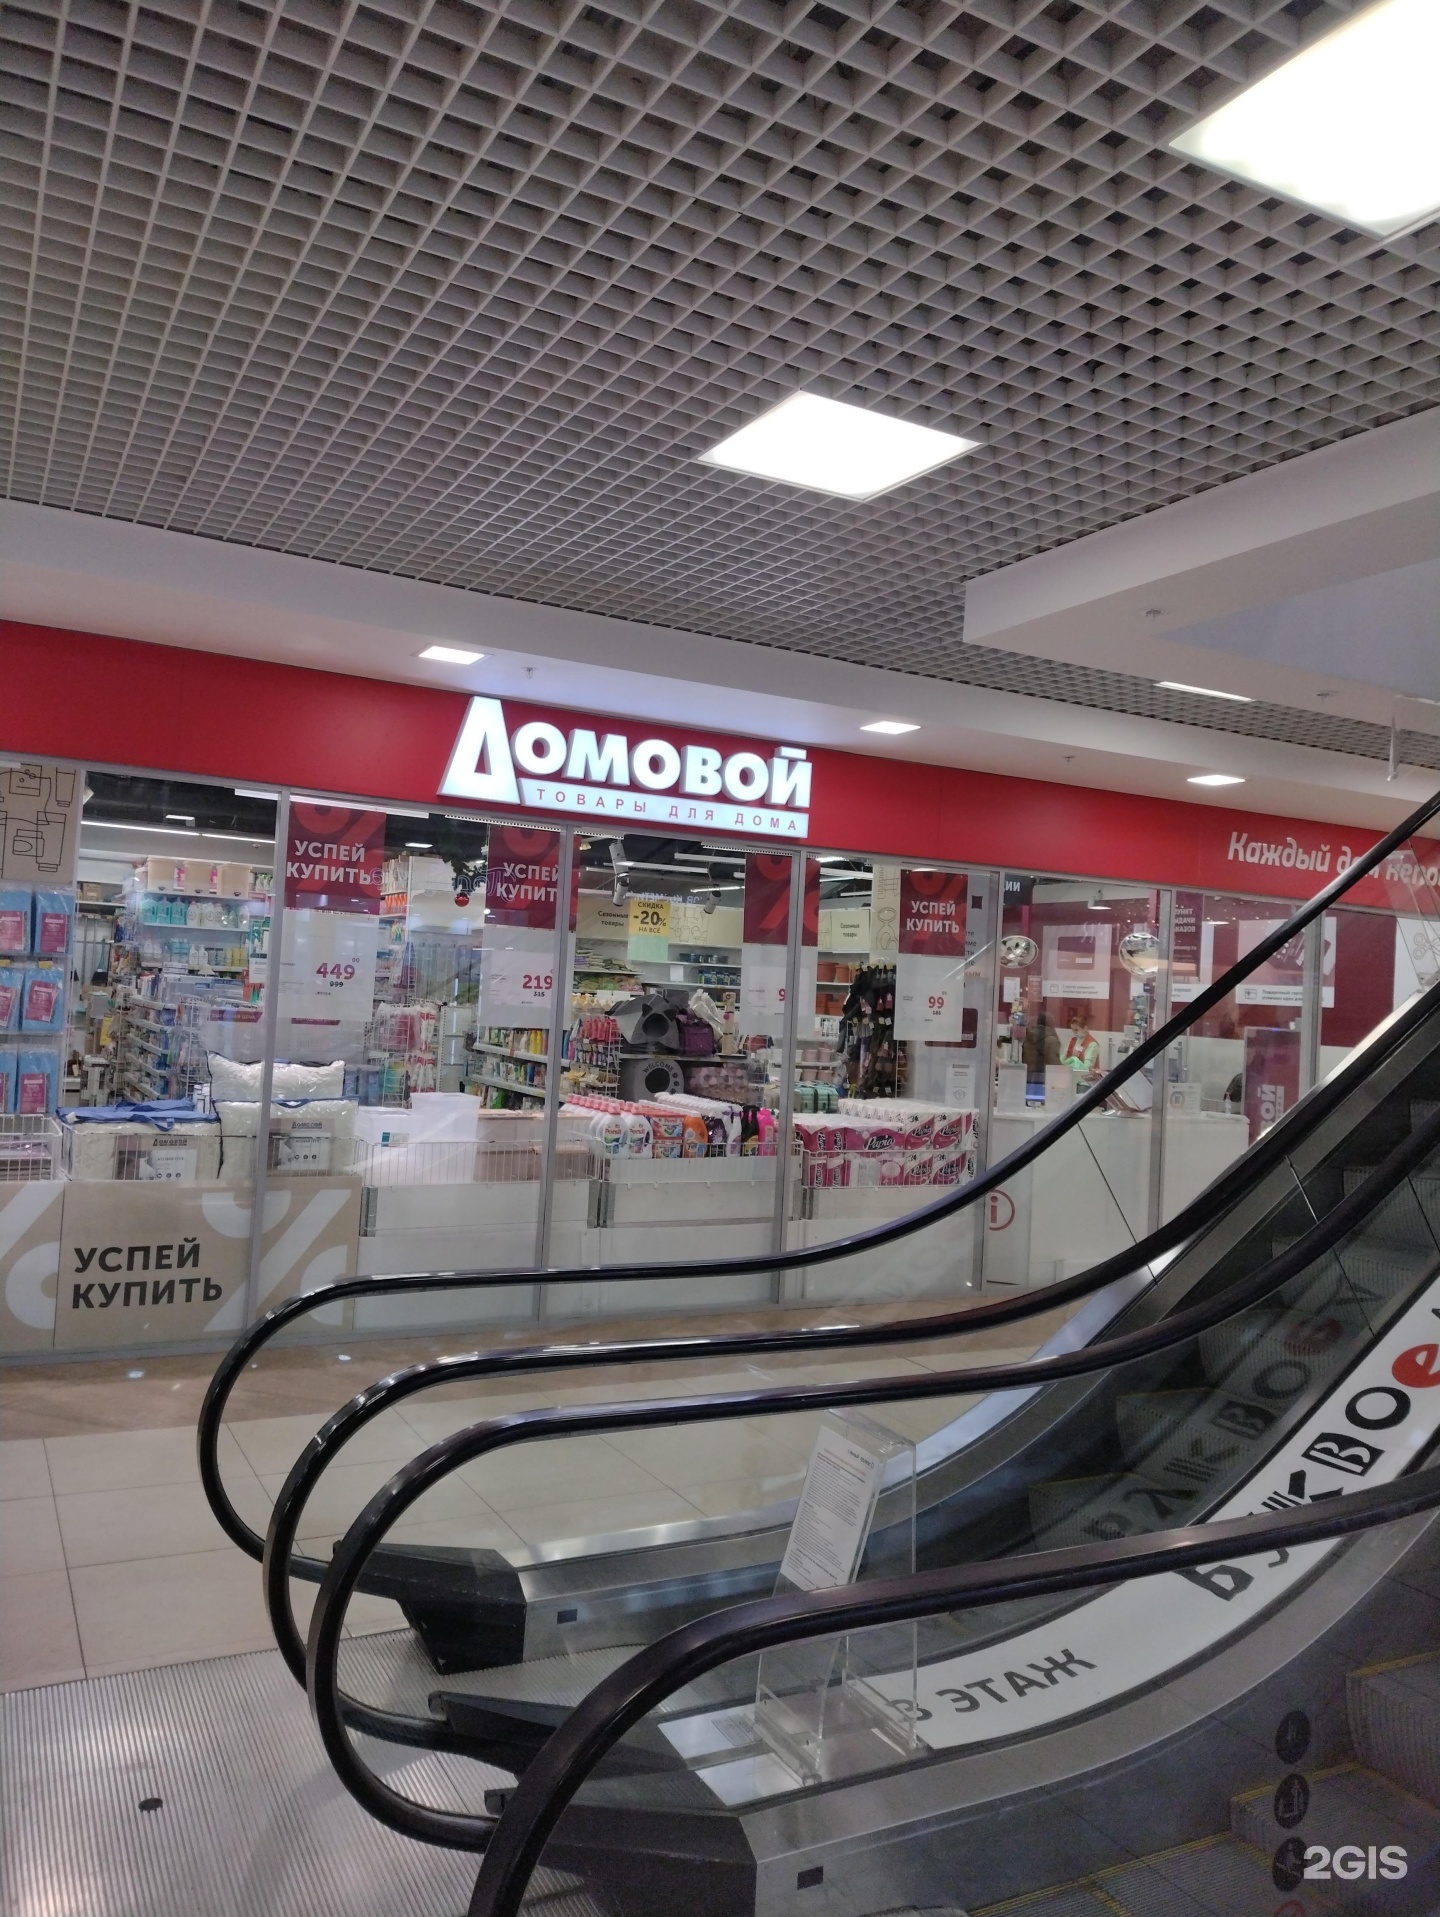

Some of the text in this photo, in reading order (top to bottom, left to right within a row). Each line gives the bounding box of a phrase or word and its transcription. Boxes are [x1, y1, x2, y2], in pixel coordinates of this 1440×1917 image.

[437, 696, 812, 808] ДОМОВОЙ
[537, 788, 797, 832] ТОВАРЫ ДЛЯ ДОМА
[295, 839, 366, 863] УСПЕЙ
[1227, 831, 1331, 873] Каждый
[1385, 863, 1440, 887] непо
[286, 862, 372, 885] КУПИТЬ
[496, 882, 558, 902] КУПИТ
[637, 901, 664, 910] СКИДКА
[911, 900, 956, 916] УСПЕЙ
[597, 910, 629, 919] Сезонные
[633, 910, 667, 927] -20%
[601, 920, 625, 928] товары
[906, 918, 960, 934] КУПИТЬ
[316, 963, 356, 980] 449
[522, 974, 552, 990] 219
[928, 995, 945, 1009] 99
[643, 1061, 674, 1073] WELCOME
[865, 1134, 894, 1151] Papia
[74, 1237, 200, 1274] УСПЕЙ
[72, 1277, 223, 1309] КУПИТЬ
[934, 1648, 1098, 1713] ЭТАЖ
